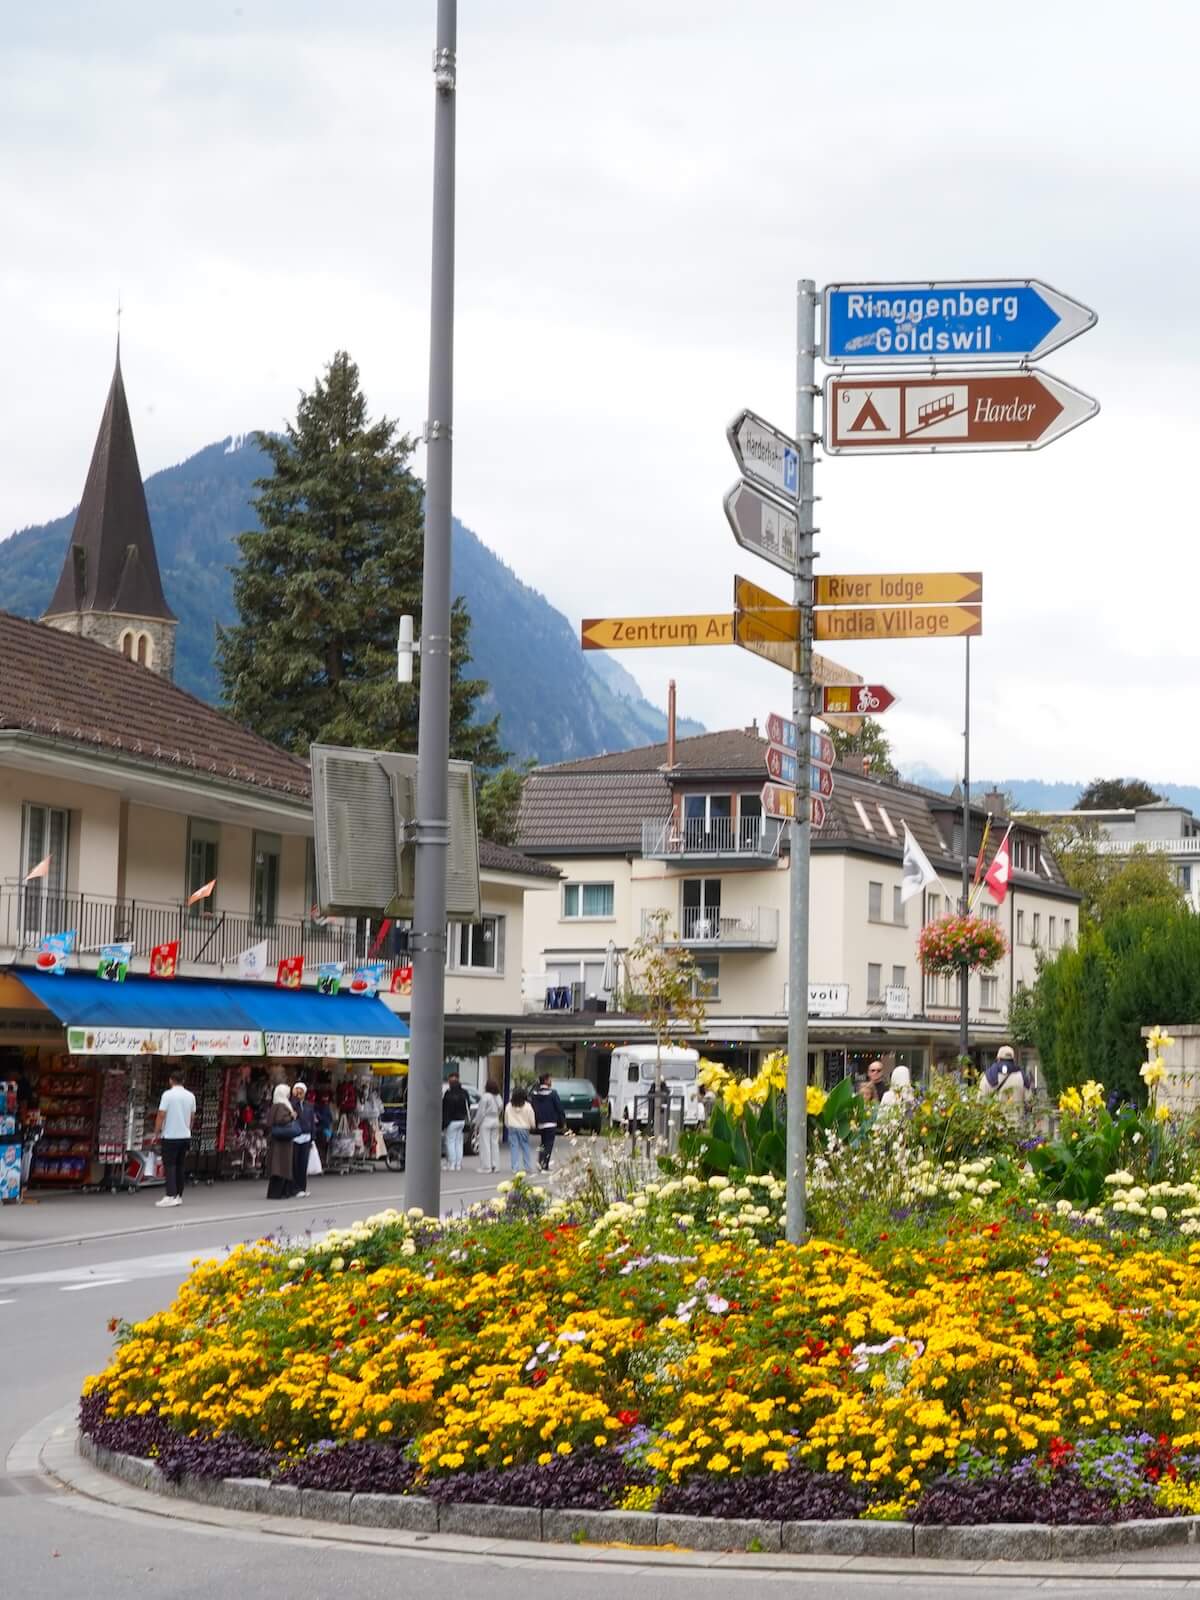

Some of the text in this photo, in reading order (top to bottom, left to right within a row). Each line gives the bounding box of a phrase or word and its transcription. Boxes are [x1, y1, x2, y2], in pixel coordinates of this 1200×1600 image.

[847, 292, 1018, 323] Ringgenberg
[875, 325, 991, 352] Goldswil
[842, 391, 1036, 423] 6 Harder
[829, 577, 924, 600] River lodge
[612, 621, 698, 641] Zentrum
[827, 609, 949, 634] India Village
[810, 988, 838, 1000] voli
